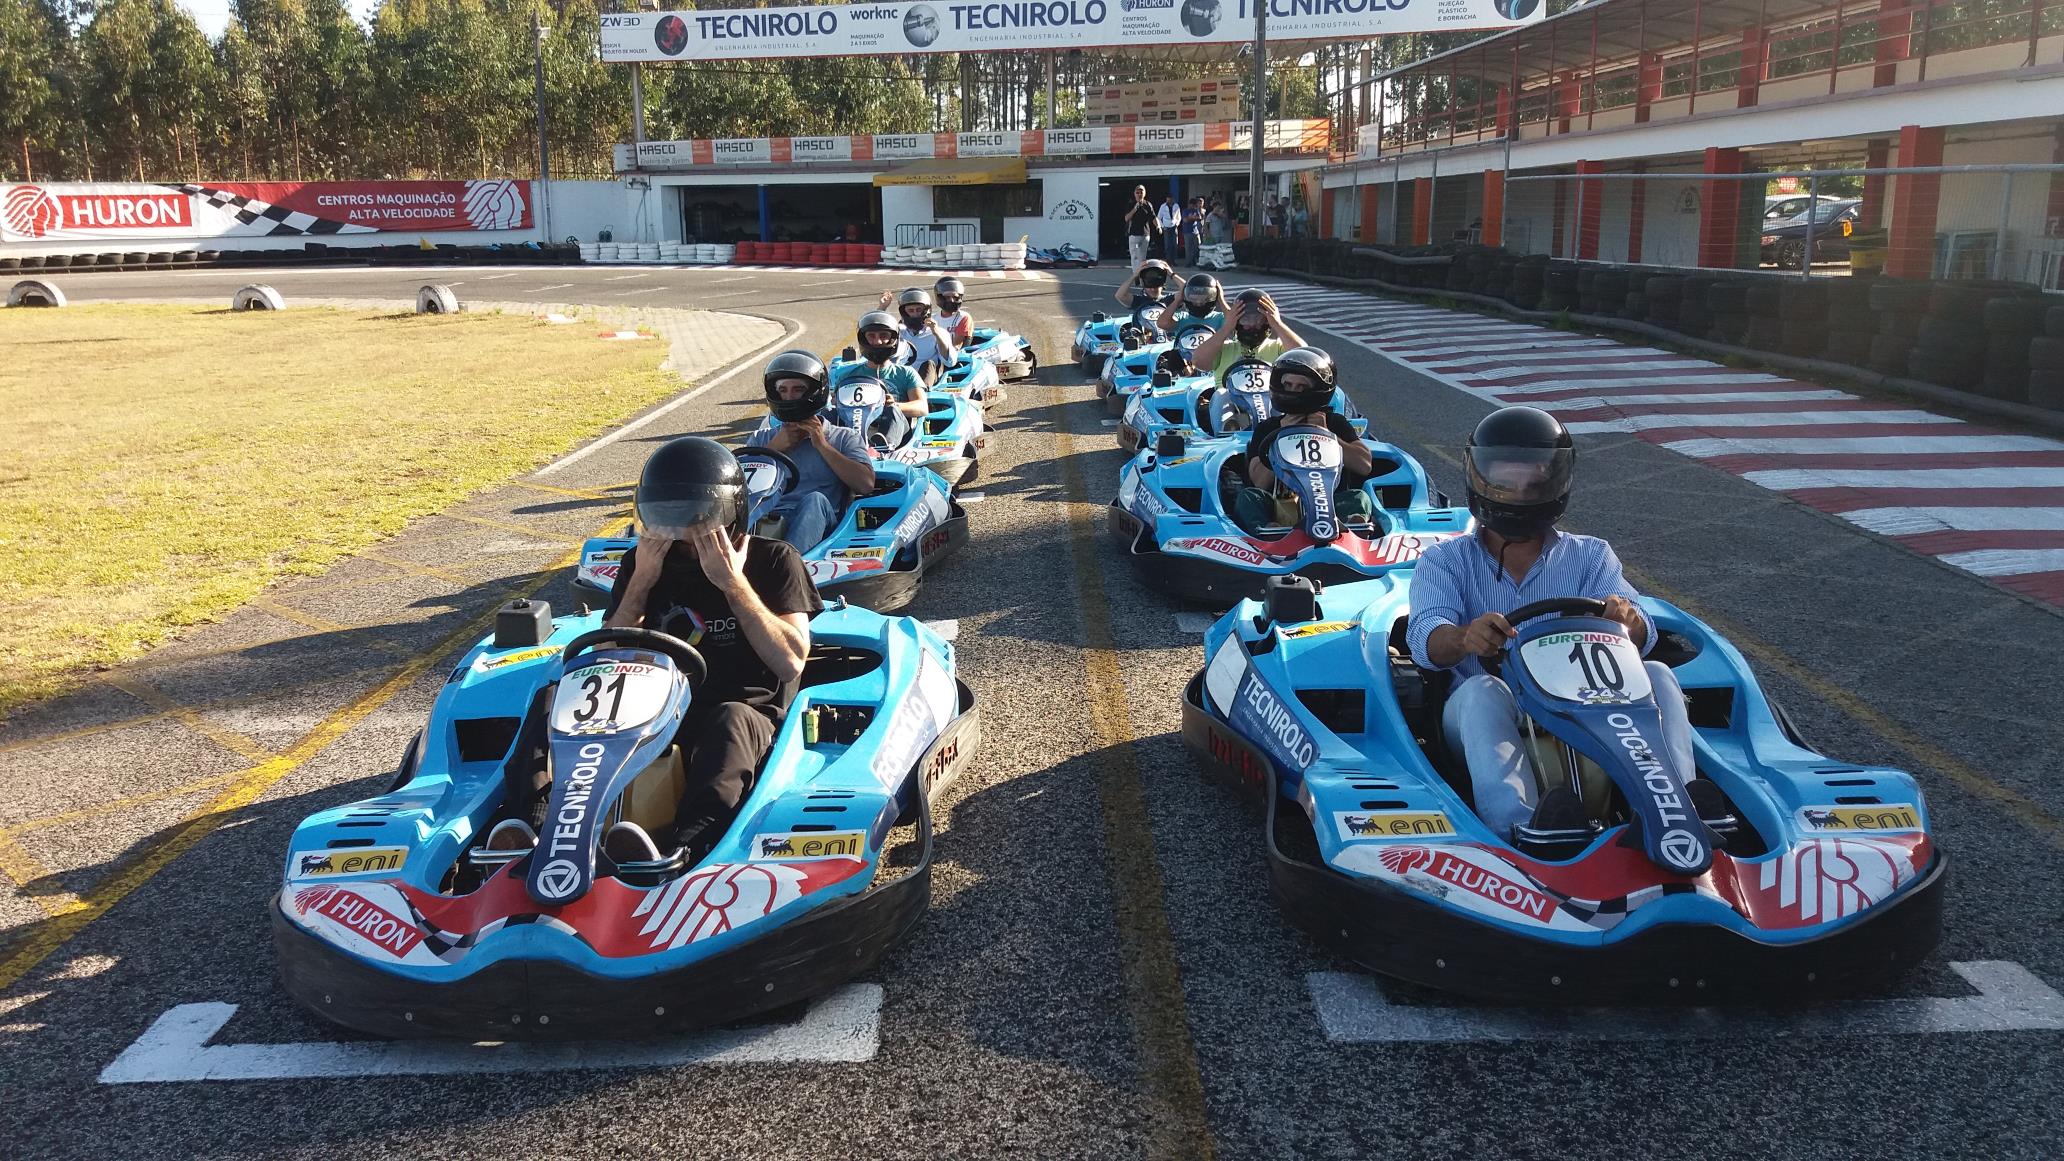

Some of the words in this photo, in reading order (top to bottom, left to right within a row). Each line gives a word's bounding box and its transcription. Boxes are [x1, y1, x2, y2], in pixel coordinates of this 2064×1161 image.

[850, 6, 898, 20] worknc
[949, 0, 1106, 30] TECNIROLO
[696, 11, 837, 39] TECNIROLO
[960, 134, 1003, 146] HASCO
[1048, 131, 1092, 144] HASCO
[1138, 128, 1184, 141] HASCO
[1234, 123, 1280, 137] HACO
[639, 144, 676, 155] HASCO
[716, 142, 754, 153] HASCO
[795, 140, 834, 151] HASCO
[876, 137, 917, 149] HASCO
[317, 194, 374, 206] CENTROS
[377, 191, 456, 206] MAQUINAÇÃO
[72, 198, 182, 225] HURON
[350, 209, 380, 219] ALTA
[382, 208, 456, 219] VELOCIDADE
[1245, 372, 1265, 388] 35
[853, 386, 864, 402] 6
[1295, 439, 1322, 463] 18
[743, 467, 758, 486] 7
[1135, 484, 1168, 515] TECNIRO
[1308, 470, 1330, 520] TECNIROLO
[1209, 540, 1260, 564] HURON
[1538, 633, 1622, 648] EUROINDY
[570, 664, 656, 681] EUROINDY
[1568, 642, 1625, 690] 10
[573, 672, 628, 724] 31
[1243, 672, 1313, 769] TECNIROLO
[1607, 713, 1688, 828] TECNIROLO
[550, 743, 606, 858] TECNIROLO
[1389, 813, 1448, 835] eni
[1853, 806, 1915, 830] eni
[802, 832, 858, 857] eni
[341, 849, 401, 874] eni
[1439, 858, 1547, 917] HURON
[330, 894, 417, 952] HURON
